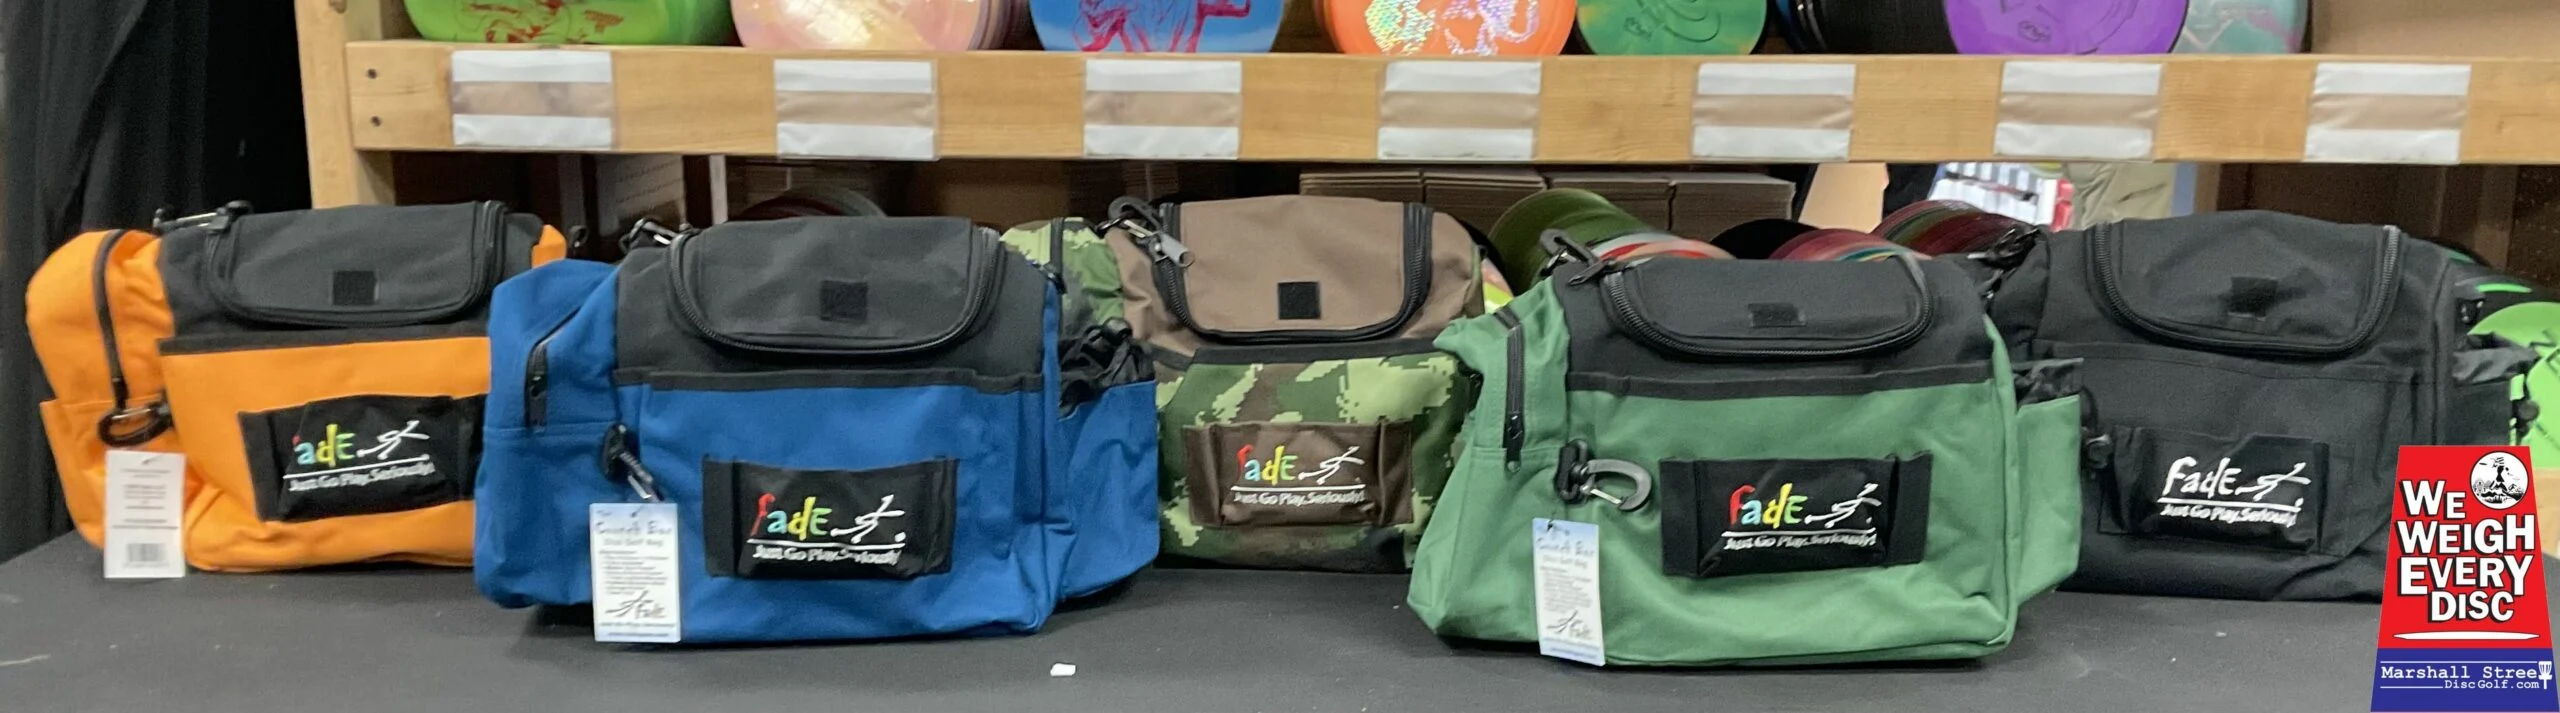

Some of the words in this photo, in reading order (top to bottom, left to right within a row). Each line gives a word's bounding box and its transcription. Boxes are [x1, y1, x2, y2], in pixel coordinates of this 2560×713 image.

[318, 475, 339, 487] Go
[1259, 492, 1279, 505] Go
[2190, 504, 2210, 519] Go
[1754, 535, 1776, 548] Go
[784, 547, 807, 561] Go
